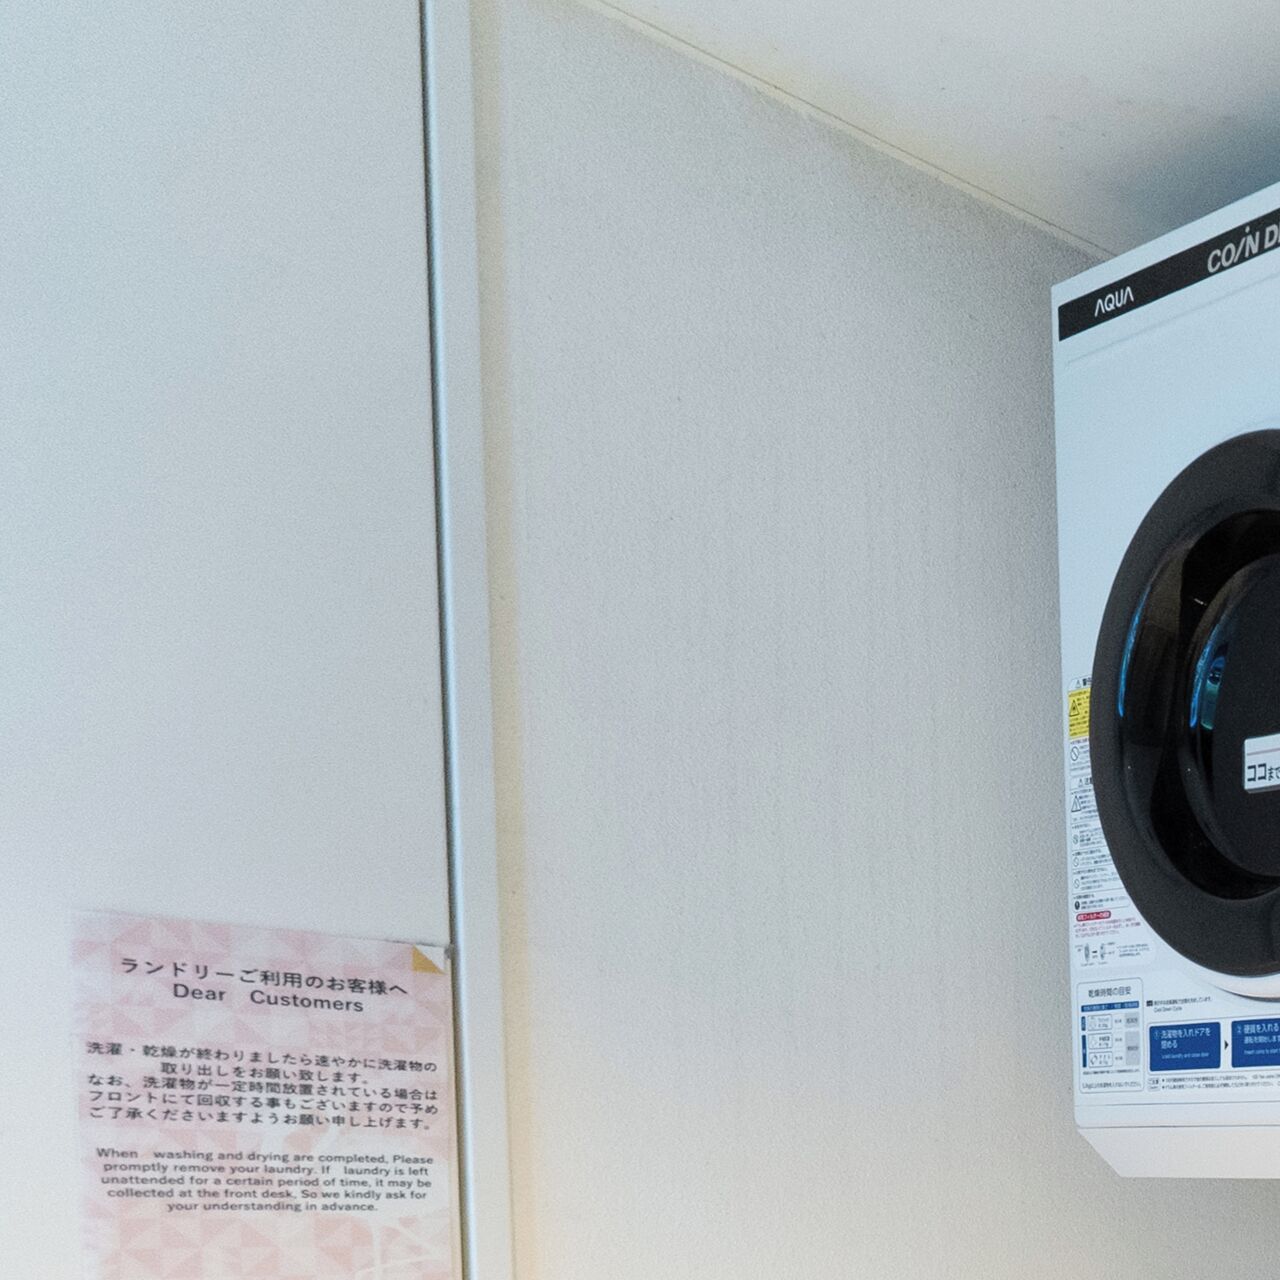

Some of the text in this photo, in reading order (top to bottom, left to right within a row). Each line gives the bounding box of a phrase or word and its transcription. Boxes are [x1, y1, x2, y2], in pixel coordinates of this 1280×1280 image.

[1094, 286, 1134, 318] AQUA
[121, 957, 408, 996] ランドリーご利用のお客様へ
[173, 983, 364, 1012] Dear Customers
[86, 1041, 437, 1072] 洗濯・乾燥が終わりましたら速やかに洗濯物の
[160, 1062, 368, 1085] 取り出しをお願い致します。
[88, 1073, 438, 1100] なお、洗濯物が一定時間放置されている場合は
[89, 1090, 438, 1115] フロントにて回収する事もございますので予め
[89, 1106, 430, 1130] ご了承くださいますようお願い申し上げます。
[96, 1147, 138, 1158] When
[153, 1150, 214, 1162] washing
[217, 1151, 243, 1161] and
[247, 1151, 290, 1163] drying
[293, 1154, 313, 1162] are
[392, 1154, 433, 1165] Please
[103, 1162, 429, 1177] promptly remove your laundry. If laundry is left
[101, 1175, 185, 1185] unattended
[190, 1175, 209, 1185] for
[213, 1177, 222, 1185] a
[225, 1175, 273, 1186] certain
[278, 1177, 319, 1188] period
[323, 1177, 336, 1186] of
[375, 1178, 384, 1187] it
[387, 1179, 413, 1189] may
[417, 1178, 432, 1188] be
[107, 1188, 174, 1198] collected
[179, 1189, 193, 1198] at
[197, 1188, 220, 1198] the
[224, 1188, 258, 1199] front
[301, 1189, 317, 1199] So
[321, 1191, 340, 1199] we
[344, 1189, 381, 1200] kindly
[385, 1190, 406, 1199] ask
[410, 1190, 427, 1200] for
[168, 1202, 378, 1213] your understanding in advance.
